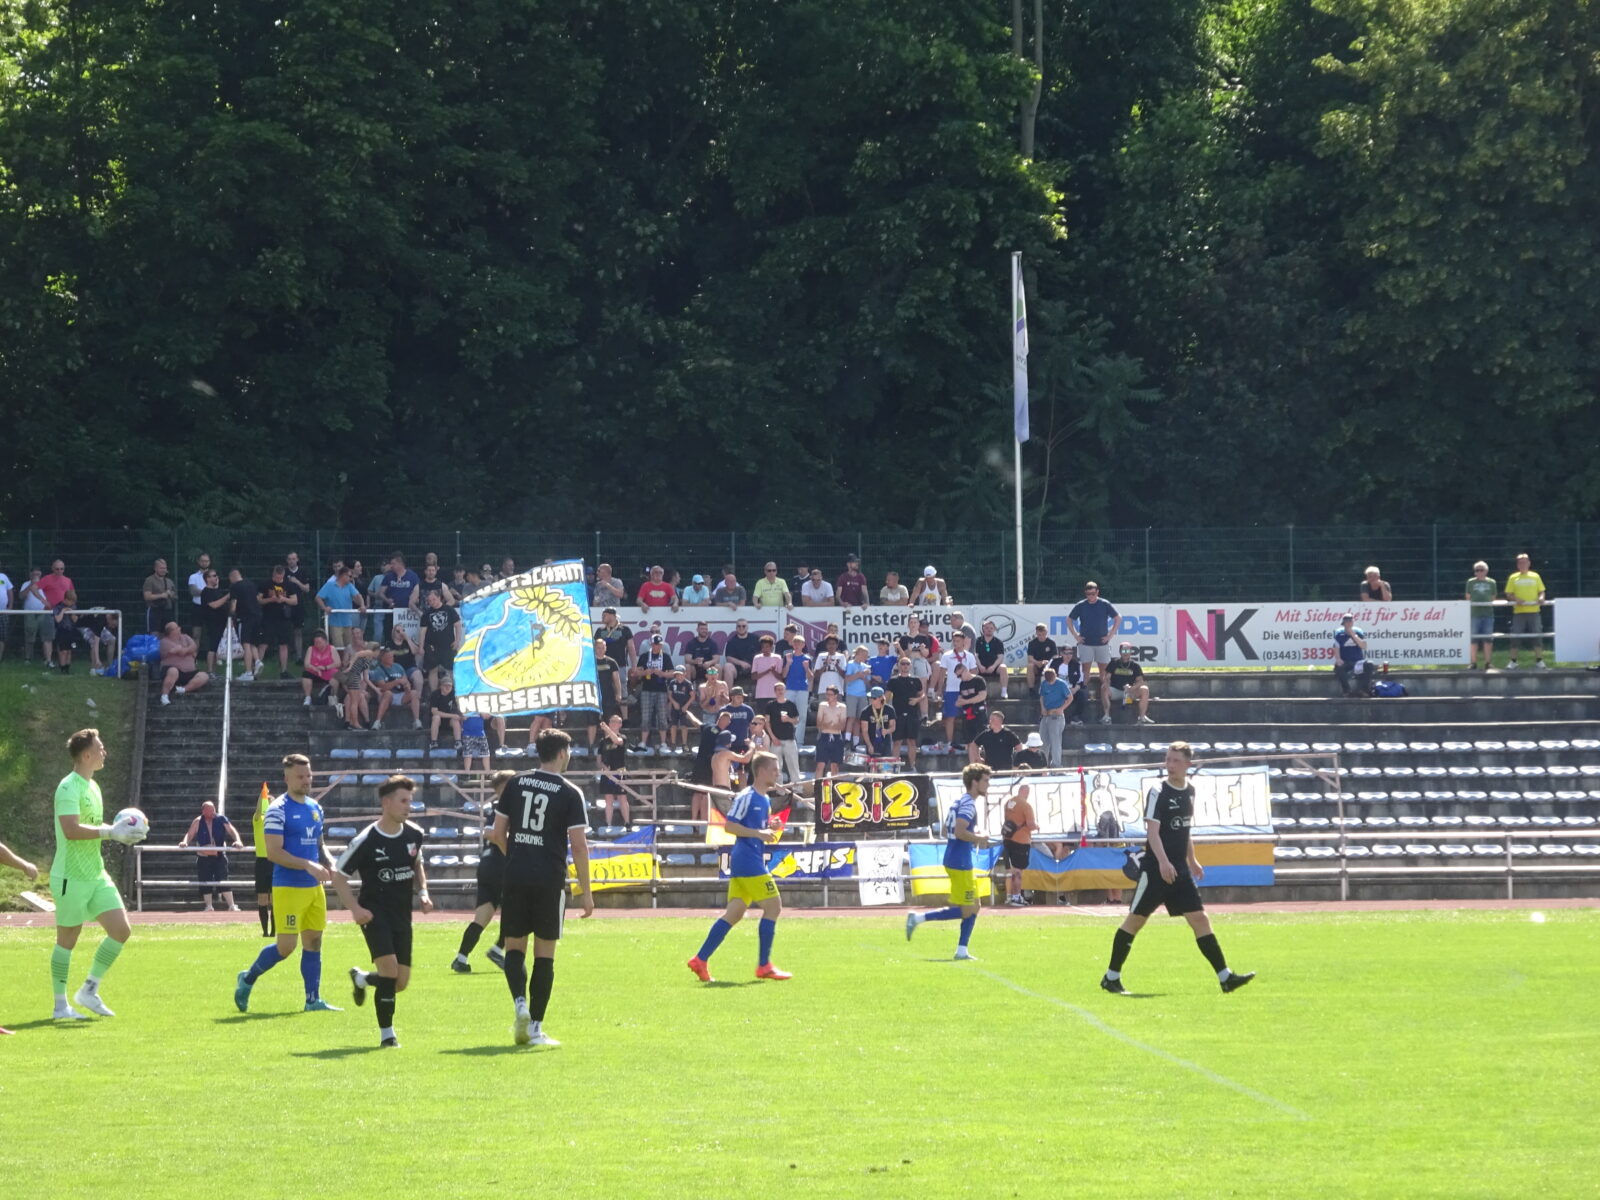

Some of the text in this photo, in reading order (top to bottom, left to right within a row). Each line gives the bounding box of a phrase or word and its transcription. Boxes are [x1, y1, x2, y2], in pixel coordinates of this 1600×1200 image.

[842, 610, 951, 626] Fenster Türe
[1275, 609, 1301, 622] Mit
[1372, 607, 1397, 626] für
[1401, 608, 1419, 621] Sie
[1424, 607, 1446, 621] da!
[1176, 608, 1260, 661] NK
[1263, 631, 1280, 641] Die
[1362, 629, 1464, 641] ersicherungsmakler
[518, 776, 562, 793] AMMENDORF
[521, 790, 549, 832] 13
[286, 915, 296, 926] 18
